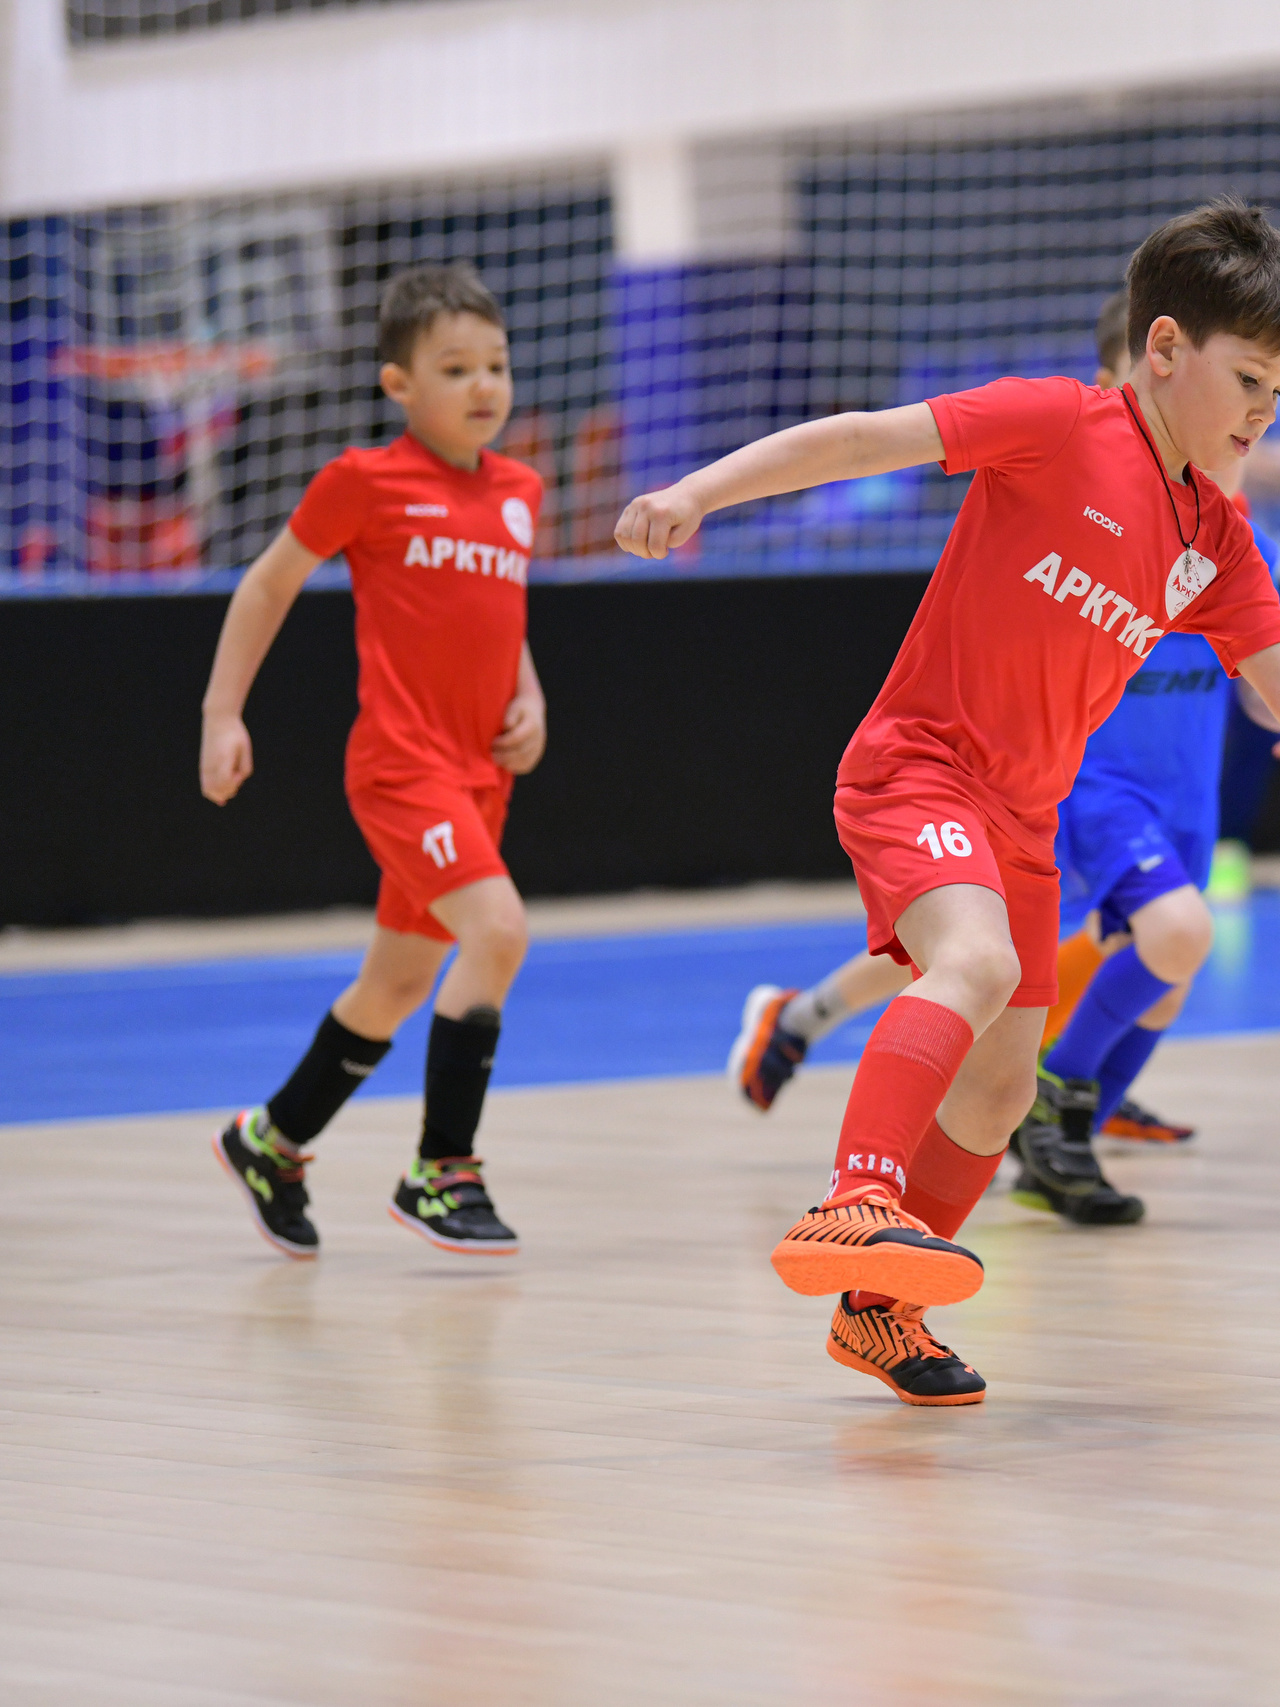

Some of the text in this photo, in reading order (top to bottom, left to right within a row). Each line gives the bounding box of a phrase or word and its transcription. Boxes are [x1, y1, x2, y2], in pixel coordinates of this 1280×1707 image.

[1083, 505, 1124, 537] KODES
[1023, 551, 1164, 659] АРКТИК
[1172, 574, 1198, 600] АРКТ
[422, 820, 458, 869] 17
[916, 821, 972, 860] 16
